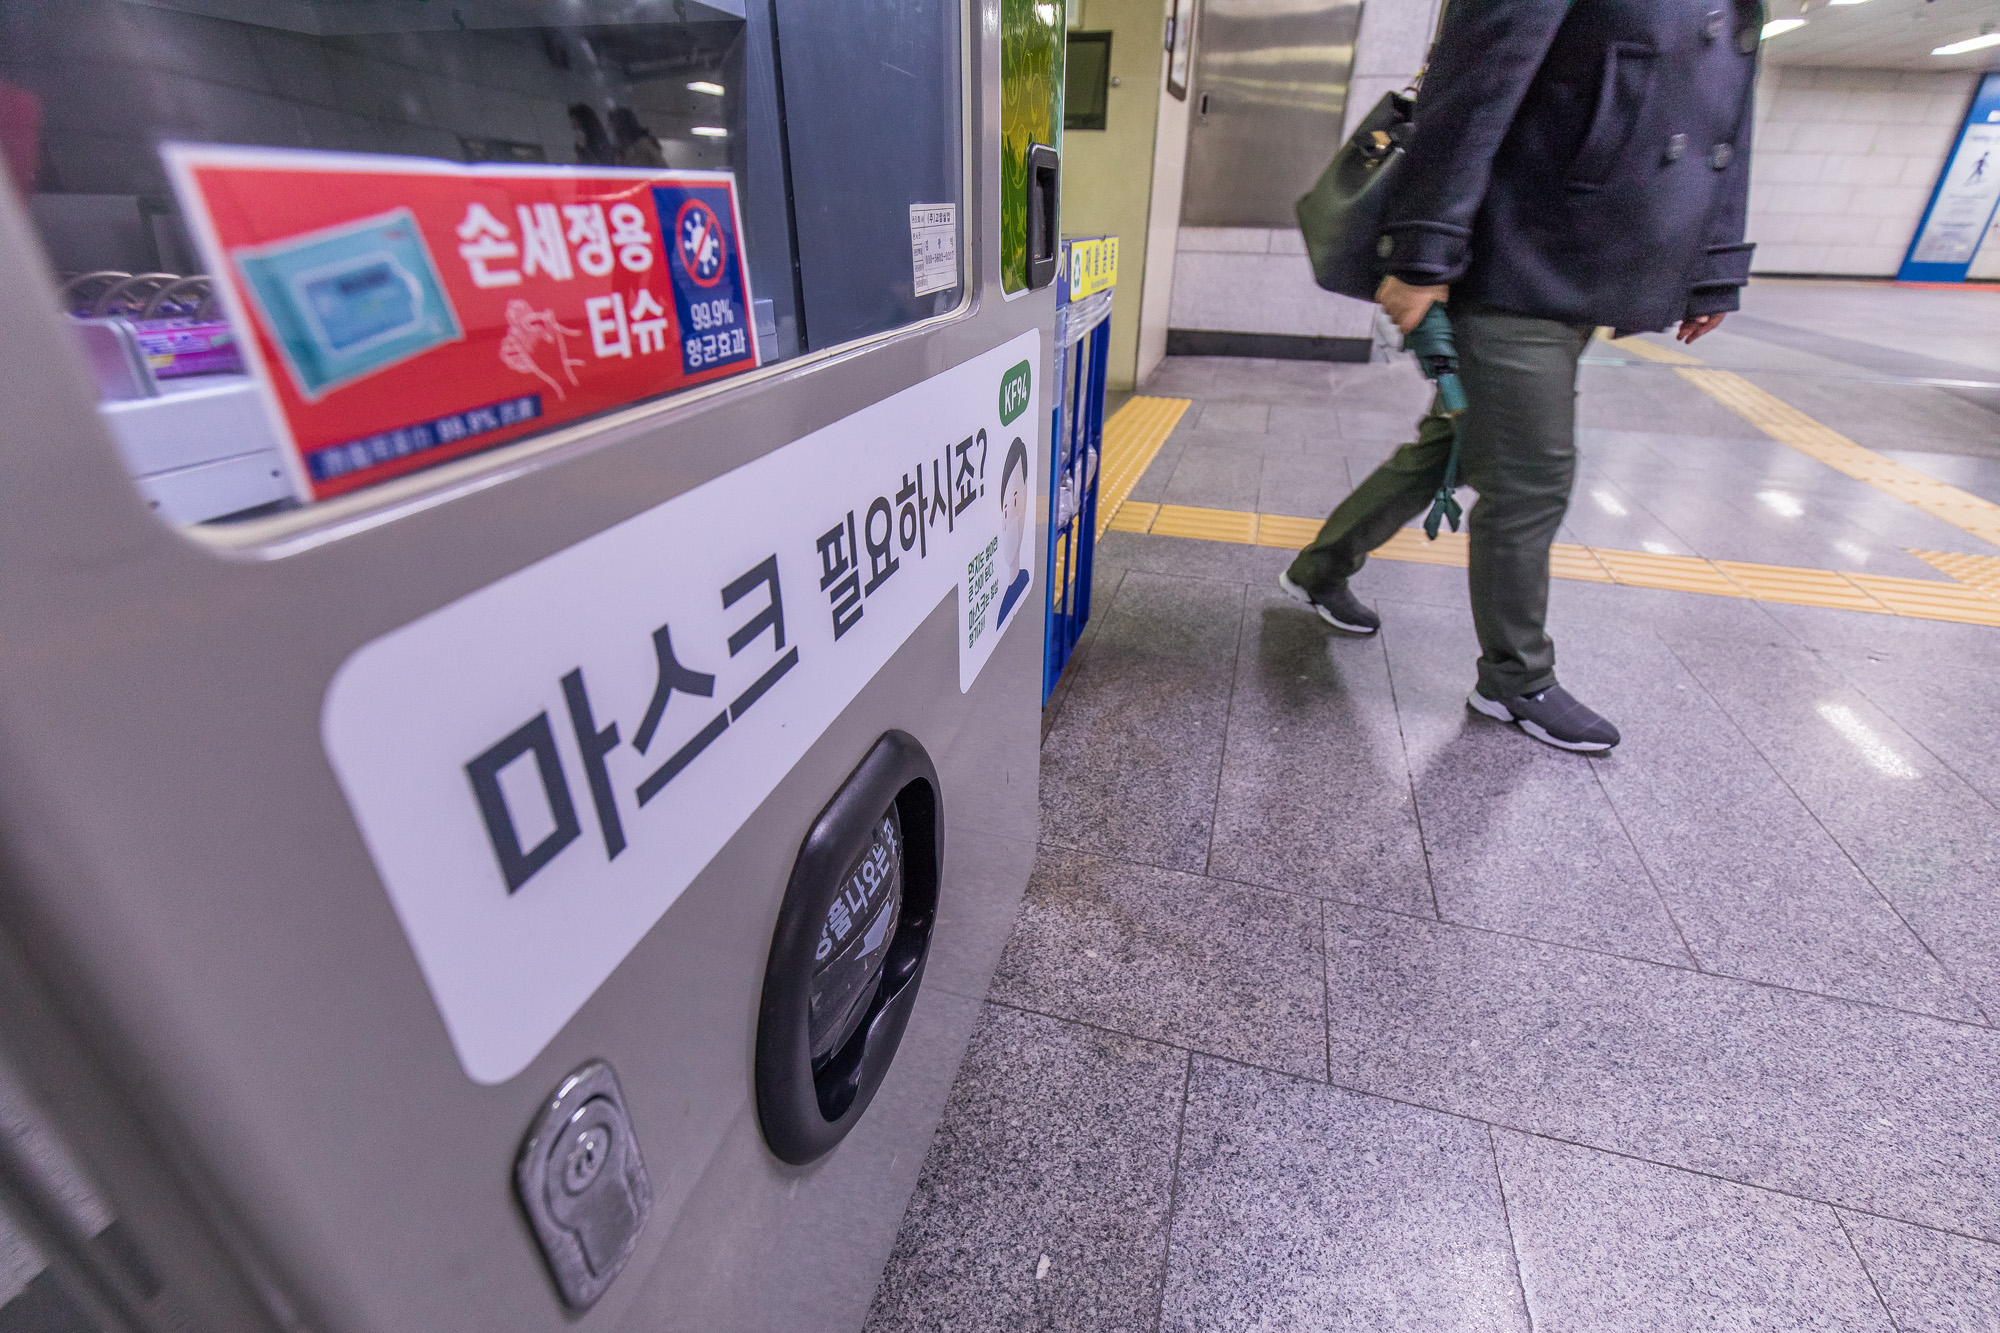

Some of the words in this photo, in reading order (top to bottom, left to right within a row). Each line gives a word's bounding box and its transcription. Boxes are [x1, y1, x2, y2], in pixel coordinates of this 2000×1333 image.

[456, 202, 655, 289] 손세정용
[585, 288, 669, 360] 티슈
[690, 301, 734, 332] 99.9%
[686, 330, 746, 369] 항균효과
[1004, 372, 1028, 416] KF94
[967, 550, 985, 584] 먼지도
[968, 592, 989, 631] 마스크는
[464, 553, 800, 897] 마스크
[816, 427, 988, 642] 필요하시죠?
